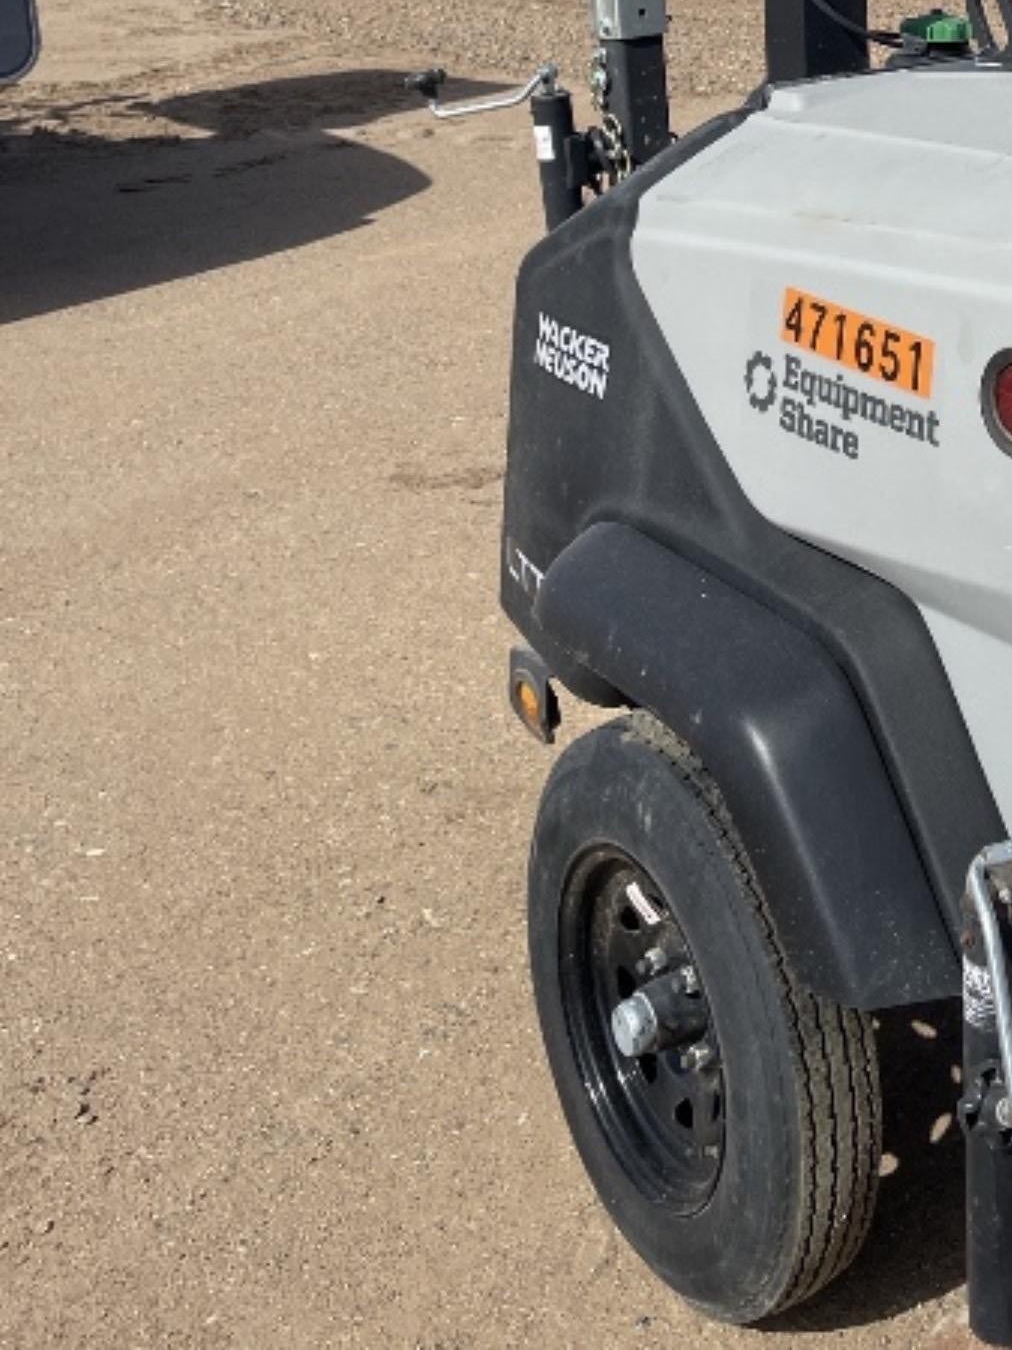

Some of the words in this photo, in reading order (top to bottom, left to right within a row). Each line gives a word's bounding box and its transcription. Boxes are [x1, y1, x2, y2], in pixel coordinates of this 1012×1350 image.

[534, 338, 607, 400] NEUSON
[538, 311, 610, 372] WACKER
[785, 297, 923, 391] 471651
[779, 398, 859, 459] Share
[783, 353, 940, 447] Equipment
